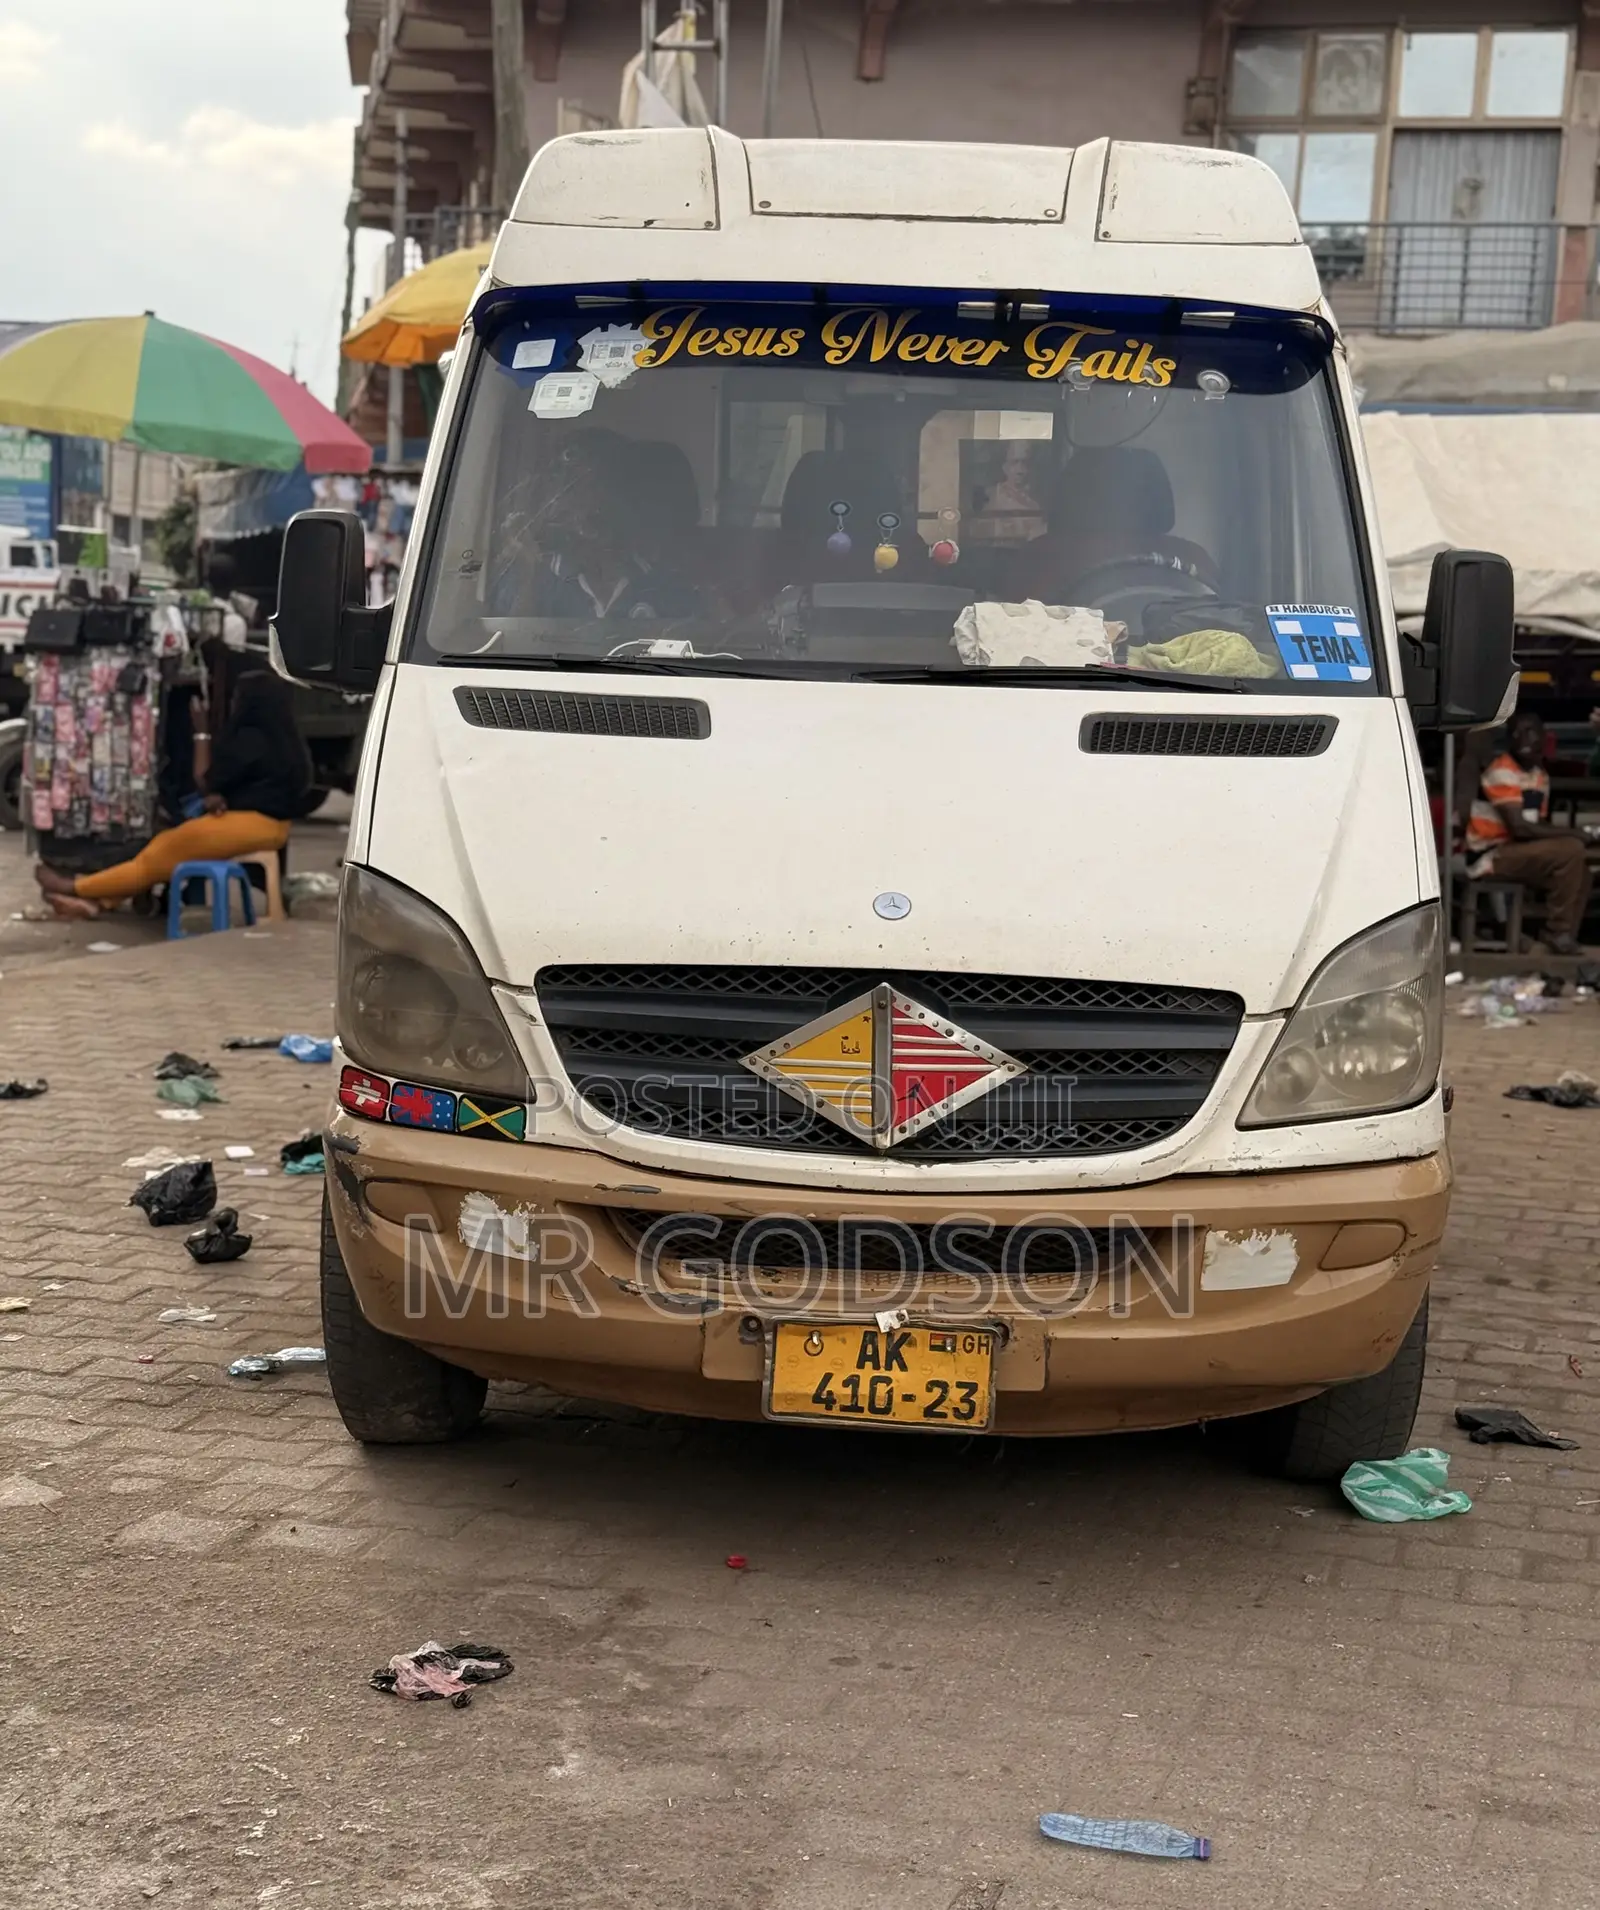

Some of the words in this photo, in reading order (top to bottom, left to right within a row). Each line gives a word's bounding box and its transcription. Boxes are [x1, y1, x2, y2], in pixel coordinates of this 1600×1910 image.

[634, 305, 806, 368] Jesus
[821, 308, 1010, 367] Never
[1023, 321, 1177, 387] Fails
[1282, 604, 1340, 615] HAMBURG
[1290, 635, 1360, 665] TEMA
[856, 1330, 912, 1372] AK
[962, 1334, 990, 1356] GH
[811, 1372, 979, 1420] 410-23
